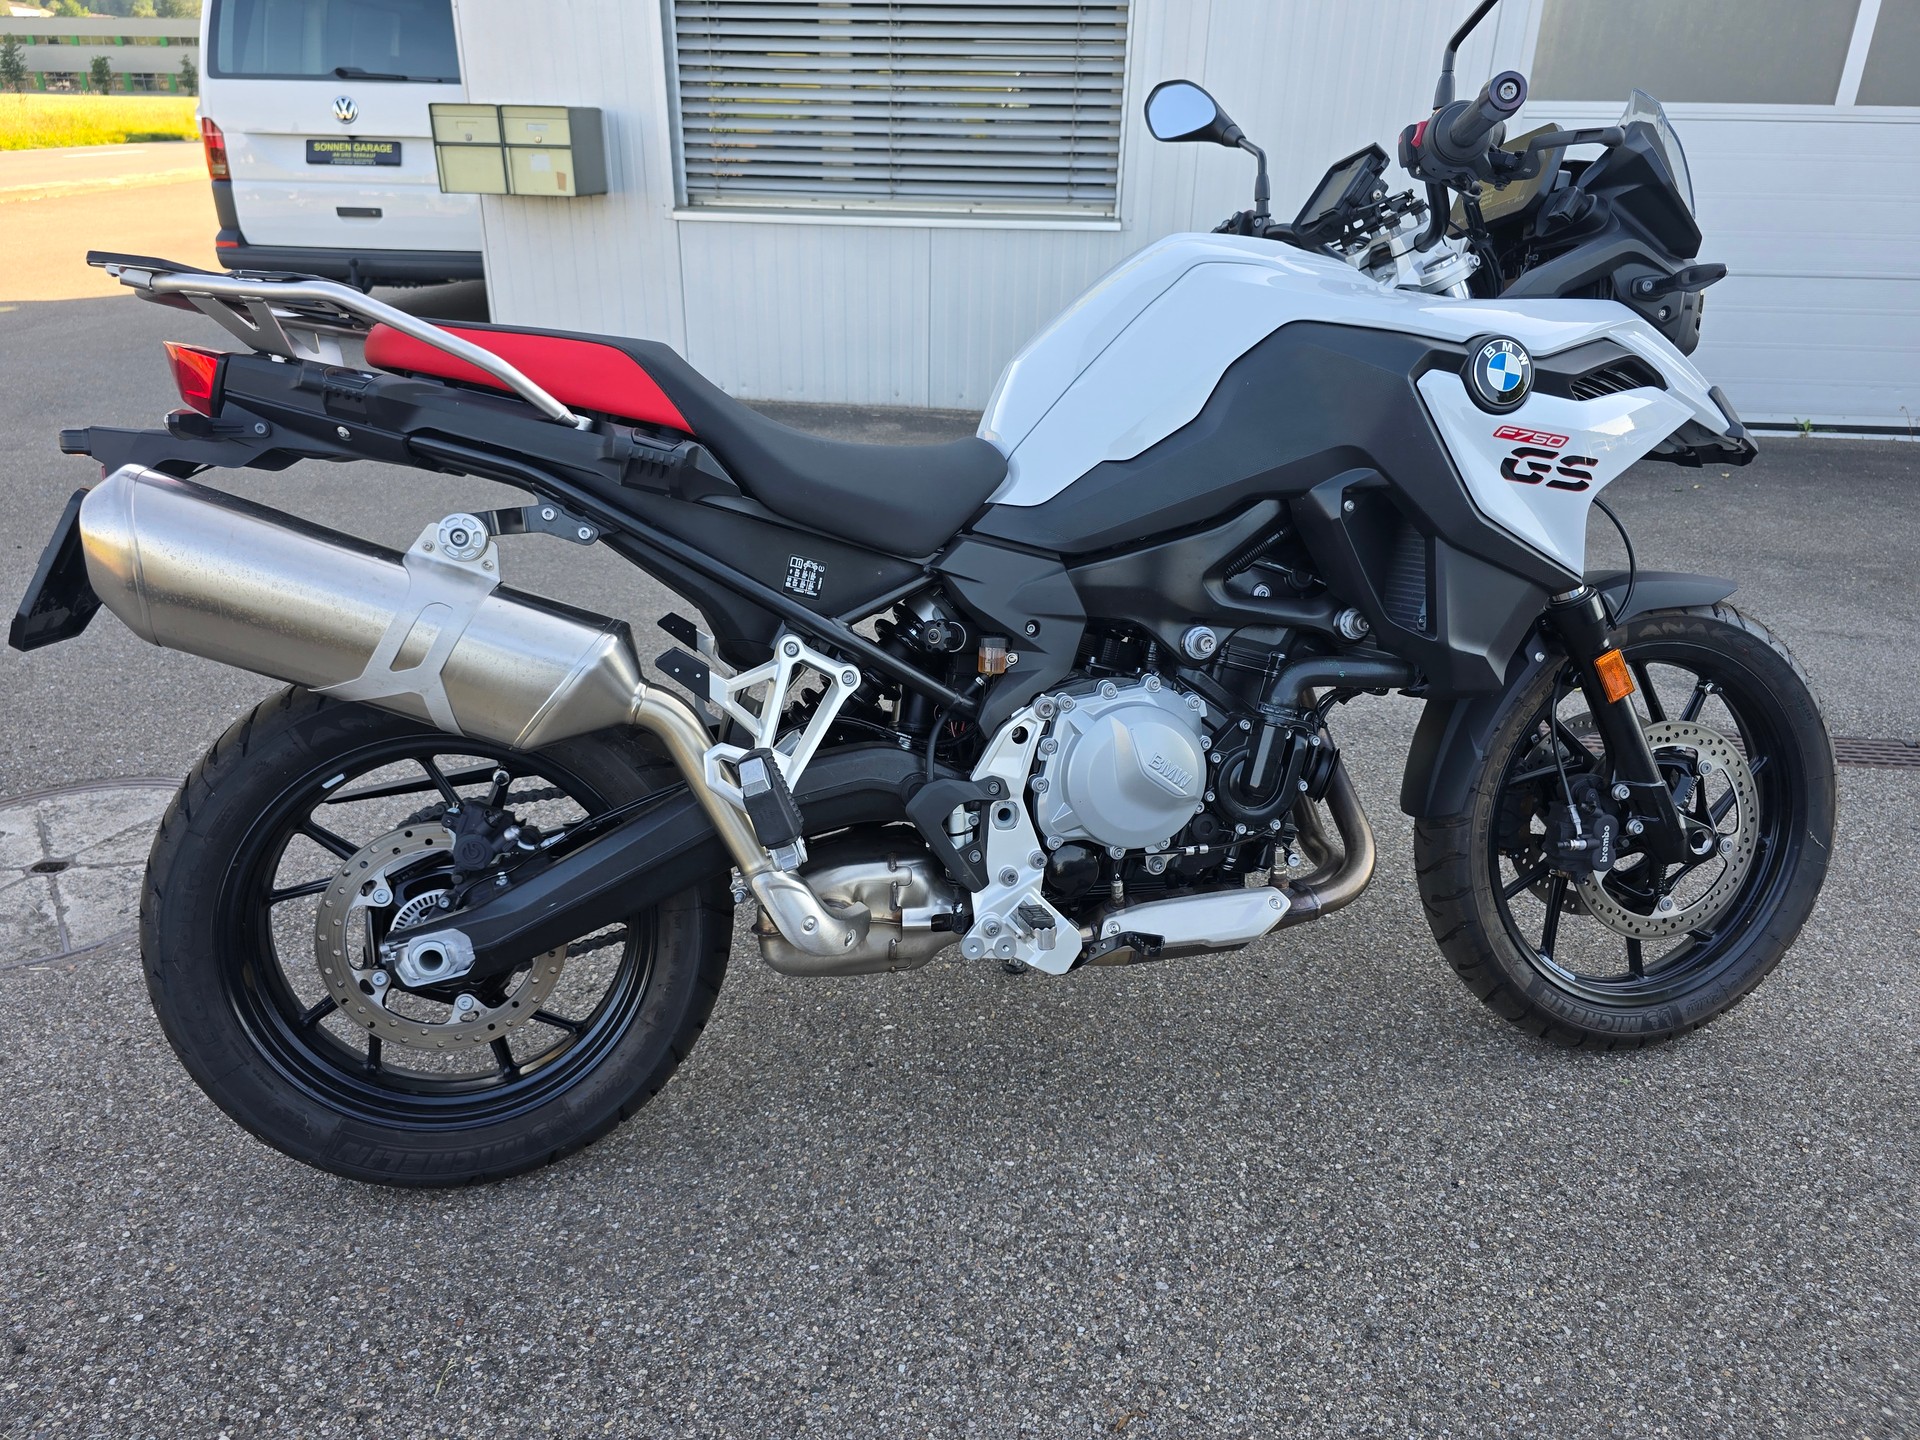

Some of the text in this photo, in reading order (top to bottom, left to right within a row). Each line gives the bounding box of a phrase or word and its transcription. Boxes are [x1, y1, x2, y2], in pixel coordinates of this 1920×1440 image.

[332, 96, 357, 122] VW
[313, 142, 393, 153] SONNEN GARAGE
[1484, 341, 1529, 366] BMW
[1495, 426, 1567, 448] F750
[1500, 446, 1599, 492] GS
[1148, 752, 1193, 789] BMW
[1599, 825, 1611, 863] brembo
[1536, 988, 1643, 1033] MICHELIN
[330, 1136, 528, 1175] MICHELIN
